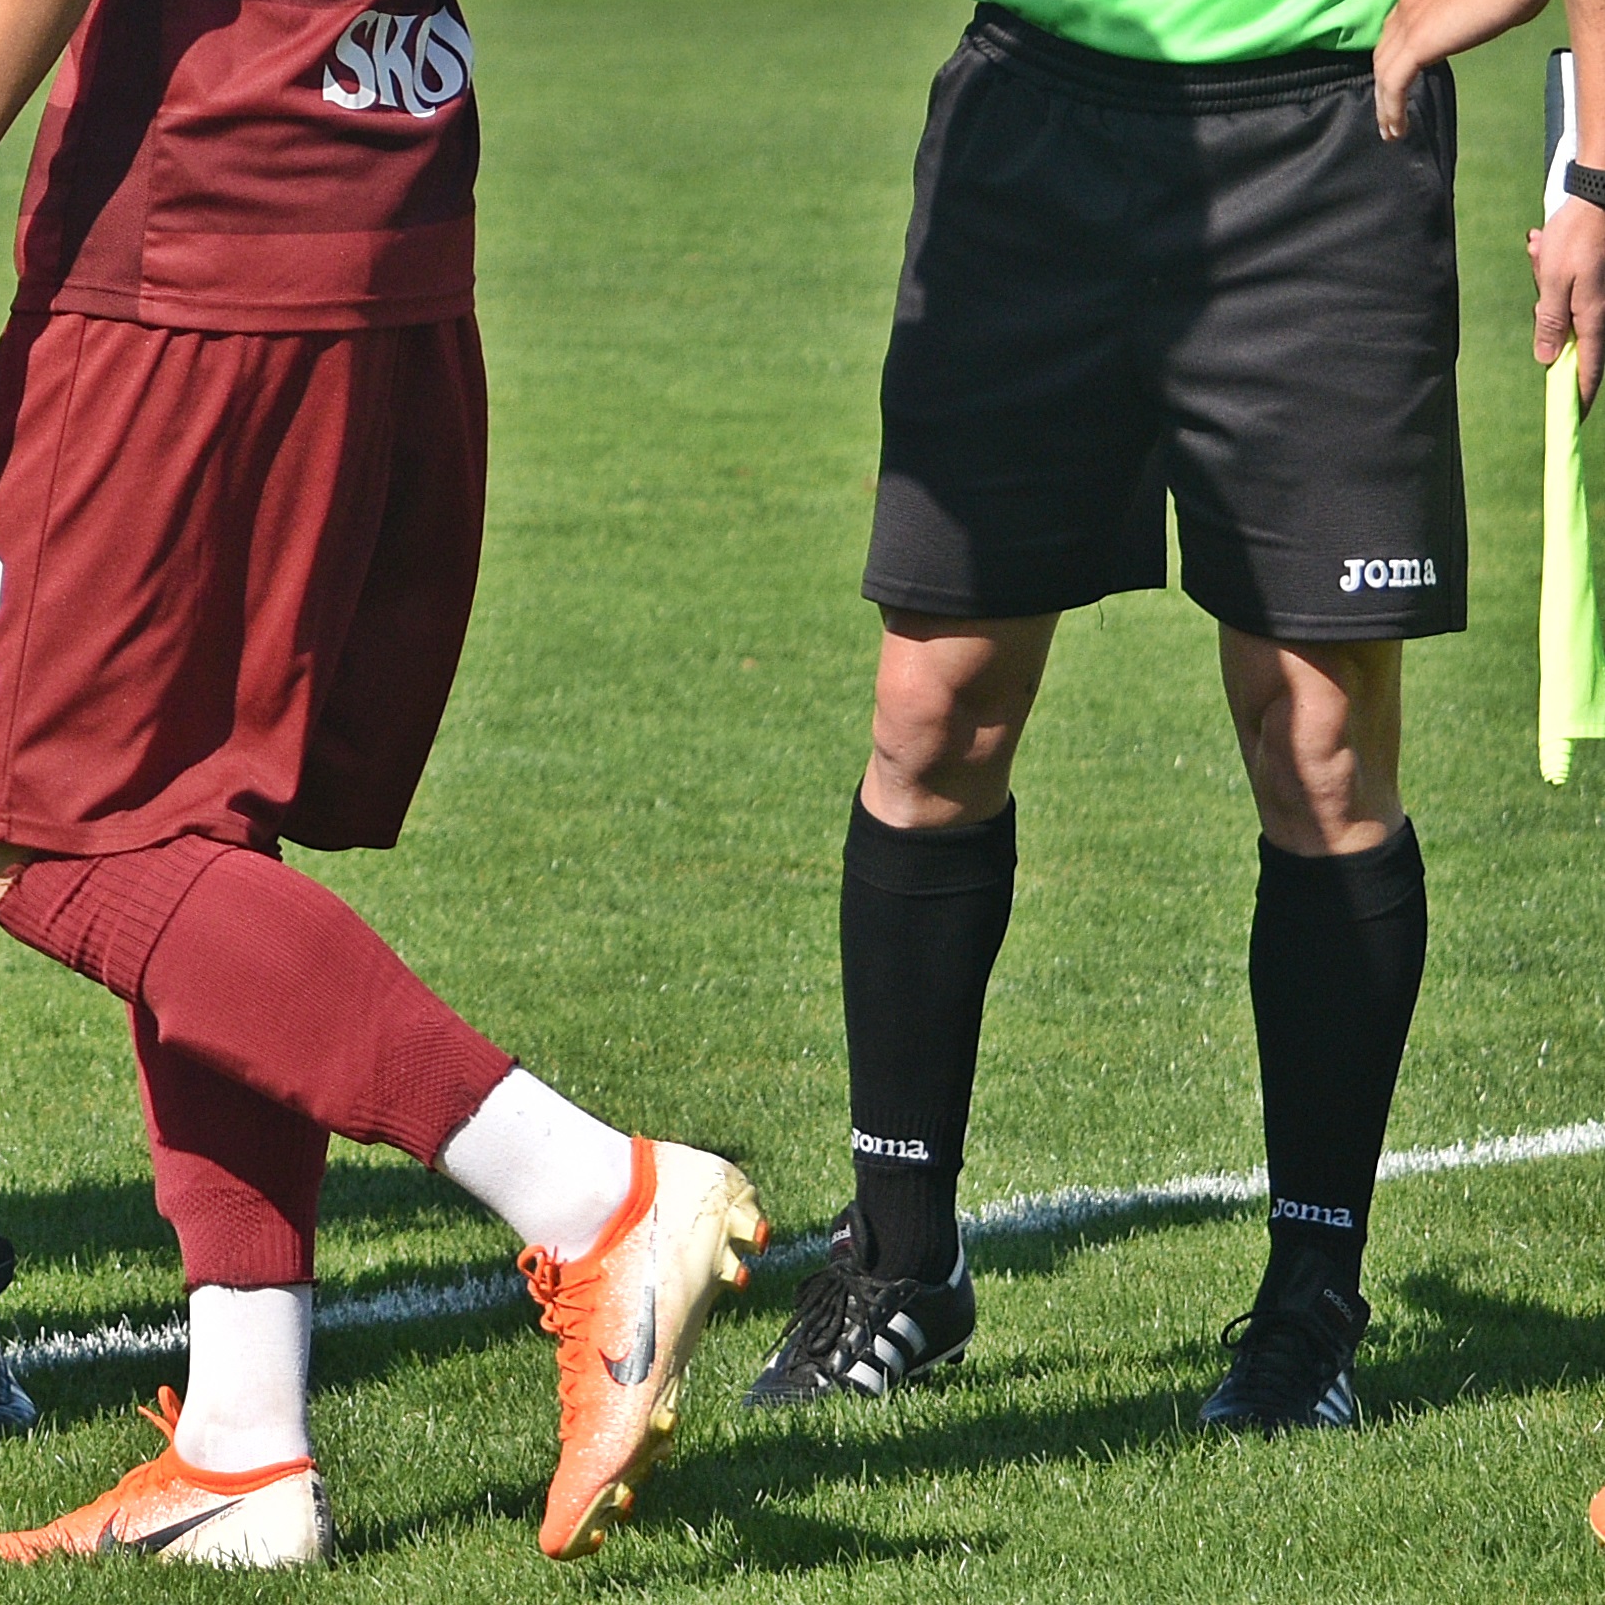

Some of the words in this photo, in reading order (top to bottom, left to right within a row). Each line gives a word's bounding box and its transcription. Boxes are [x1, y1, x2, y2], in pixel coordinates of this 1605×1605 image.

[322, 5, 475, 118] SKO
[1340, 558, 1437, 592] Joma
[1271, 1198, 1353, 1228] Joma
